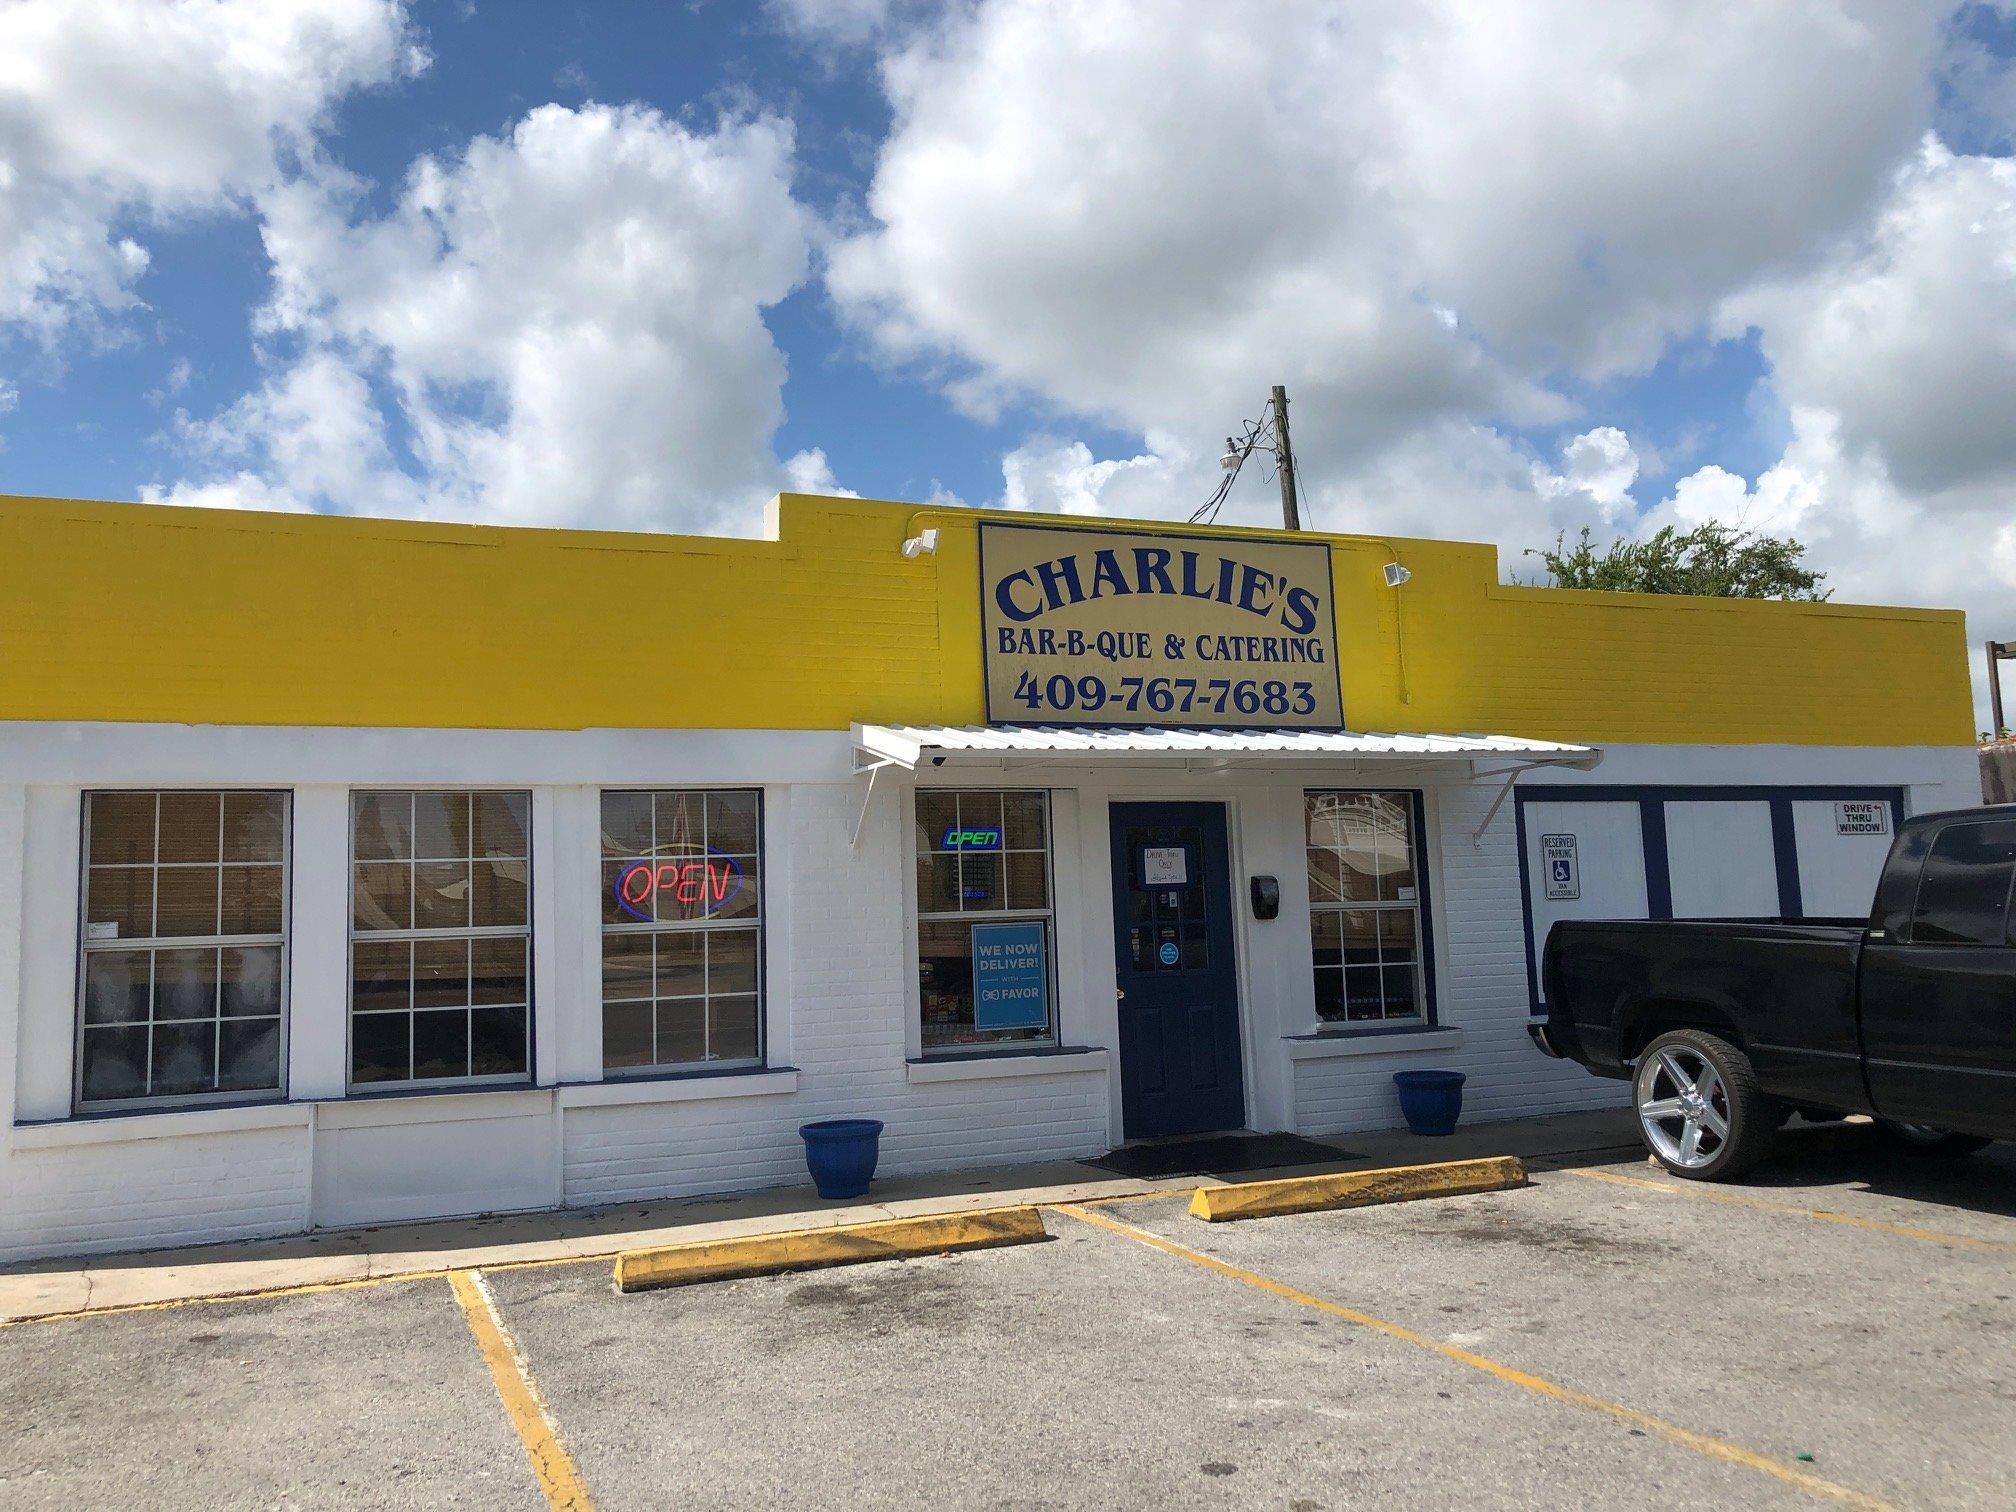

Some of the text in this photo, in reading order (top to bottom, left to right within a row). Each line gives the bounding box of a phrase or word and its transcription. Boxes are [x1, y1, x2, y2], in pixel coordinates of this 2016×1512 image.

[995, 548, 1320, 635] CHARLIE'S
[998, 627, 1325, 664] BAR-B-QUE & CATERING
[1013, 670, 1317, 716] 409-767-7683
[1843, 804, 1872, 813] DRIVE
[1845, 814, 1872, 822] THRU
[1839, 823, 1880, 832] WINDOW
[946, 831, 998, 845] OPEN
[1544, 837, 1575, 848] RESERVED
[1548, 849, 1573, 858] PARKING
[622, 863, 731, 904] OPEN
[1549, 889, 1577, 897] ACCESSIBLE
[979, 943, 1038, 956] WE NOW
[980, 957, 1039, 971] DELIVER!
[1001, 987, 1039, 1000] FAVOR
